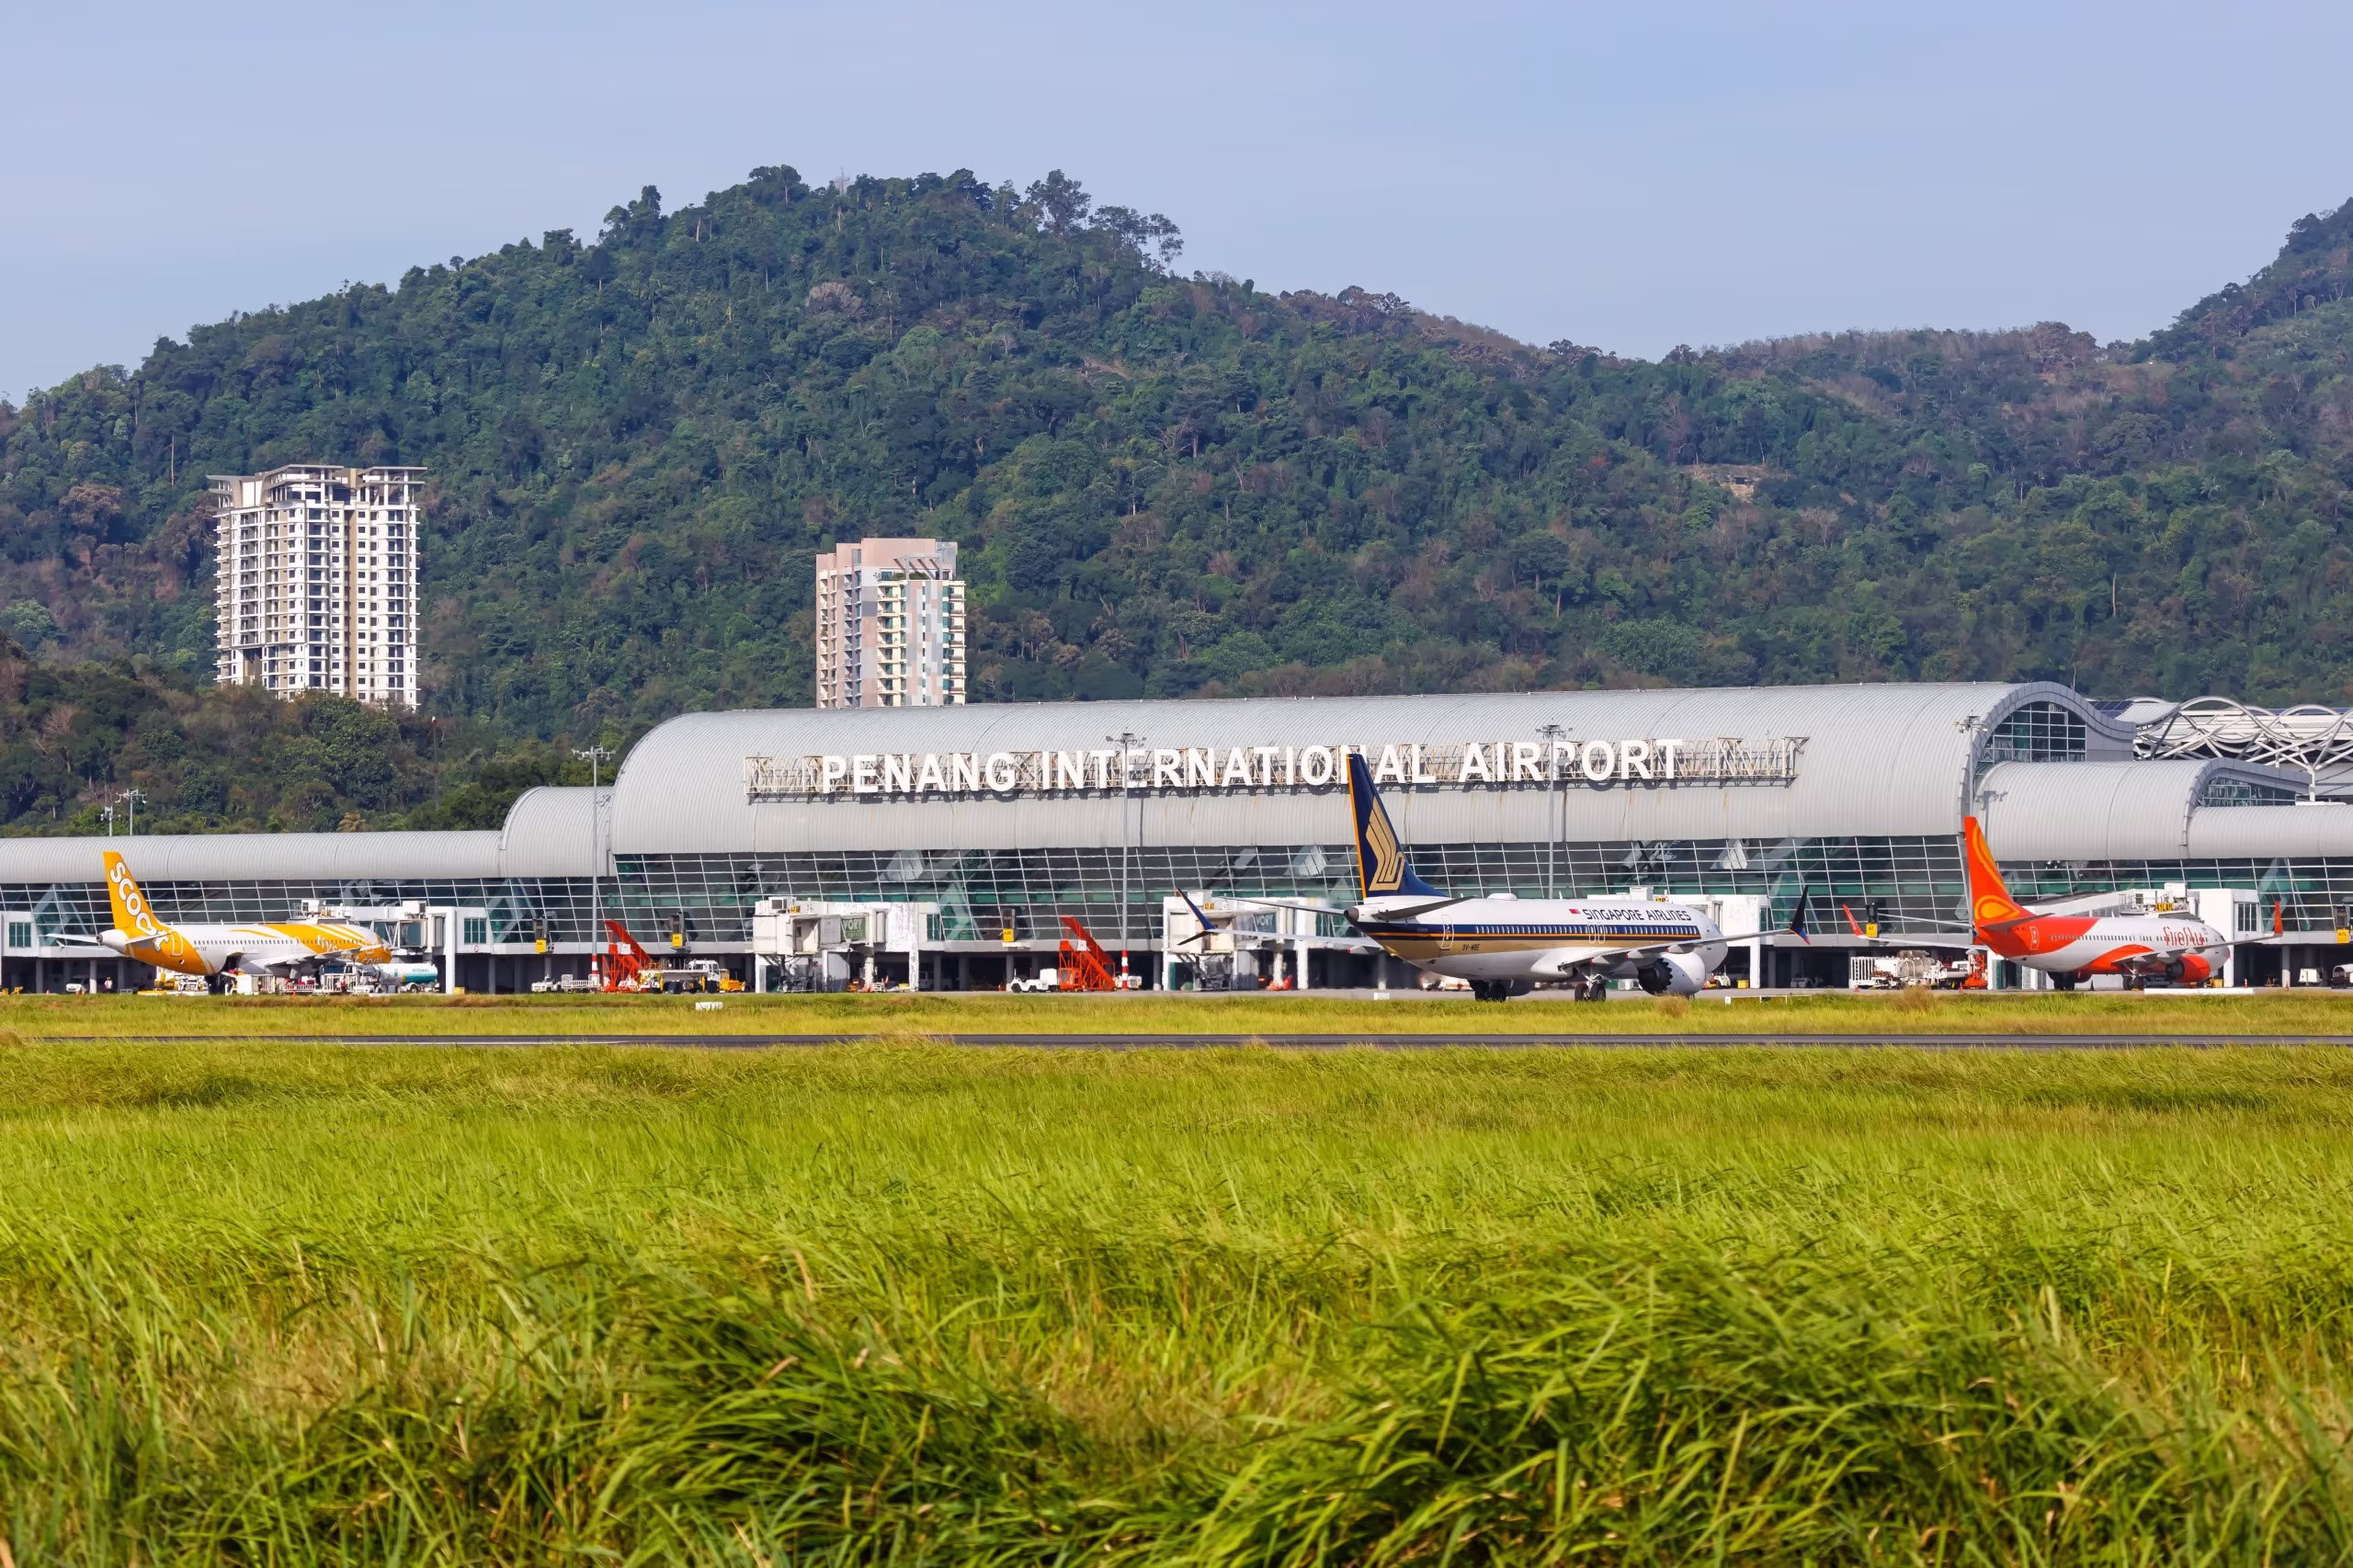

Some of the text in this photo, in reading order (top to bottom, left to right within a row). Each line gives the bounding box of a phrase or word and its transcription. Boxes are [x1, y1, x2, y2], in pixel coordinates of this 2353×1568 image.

[823, 752, 1016, 793] PENANG
[1458, 739, 1683, 783] AIRPORT
[1583, 908, 1692, 921] SINGAPORE AIRLINES
[2163, 926, 2205, 946] firefly
